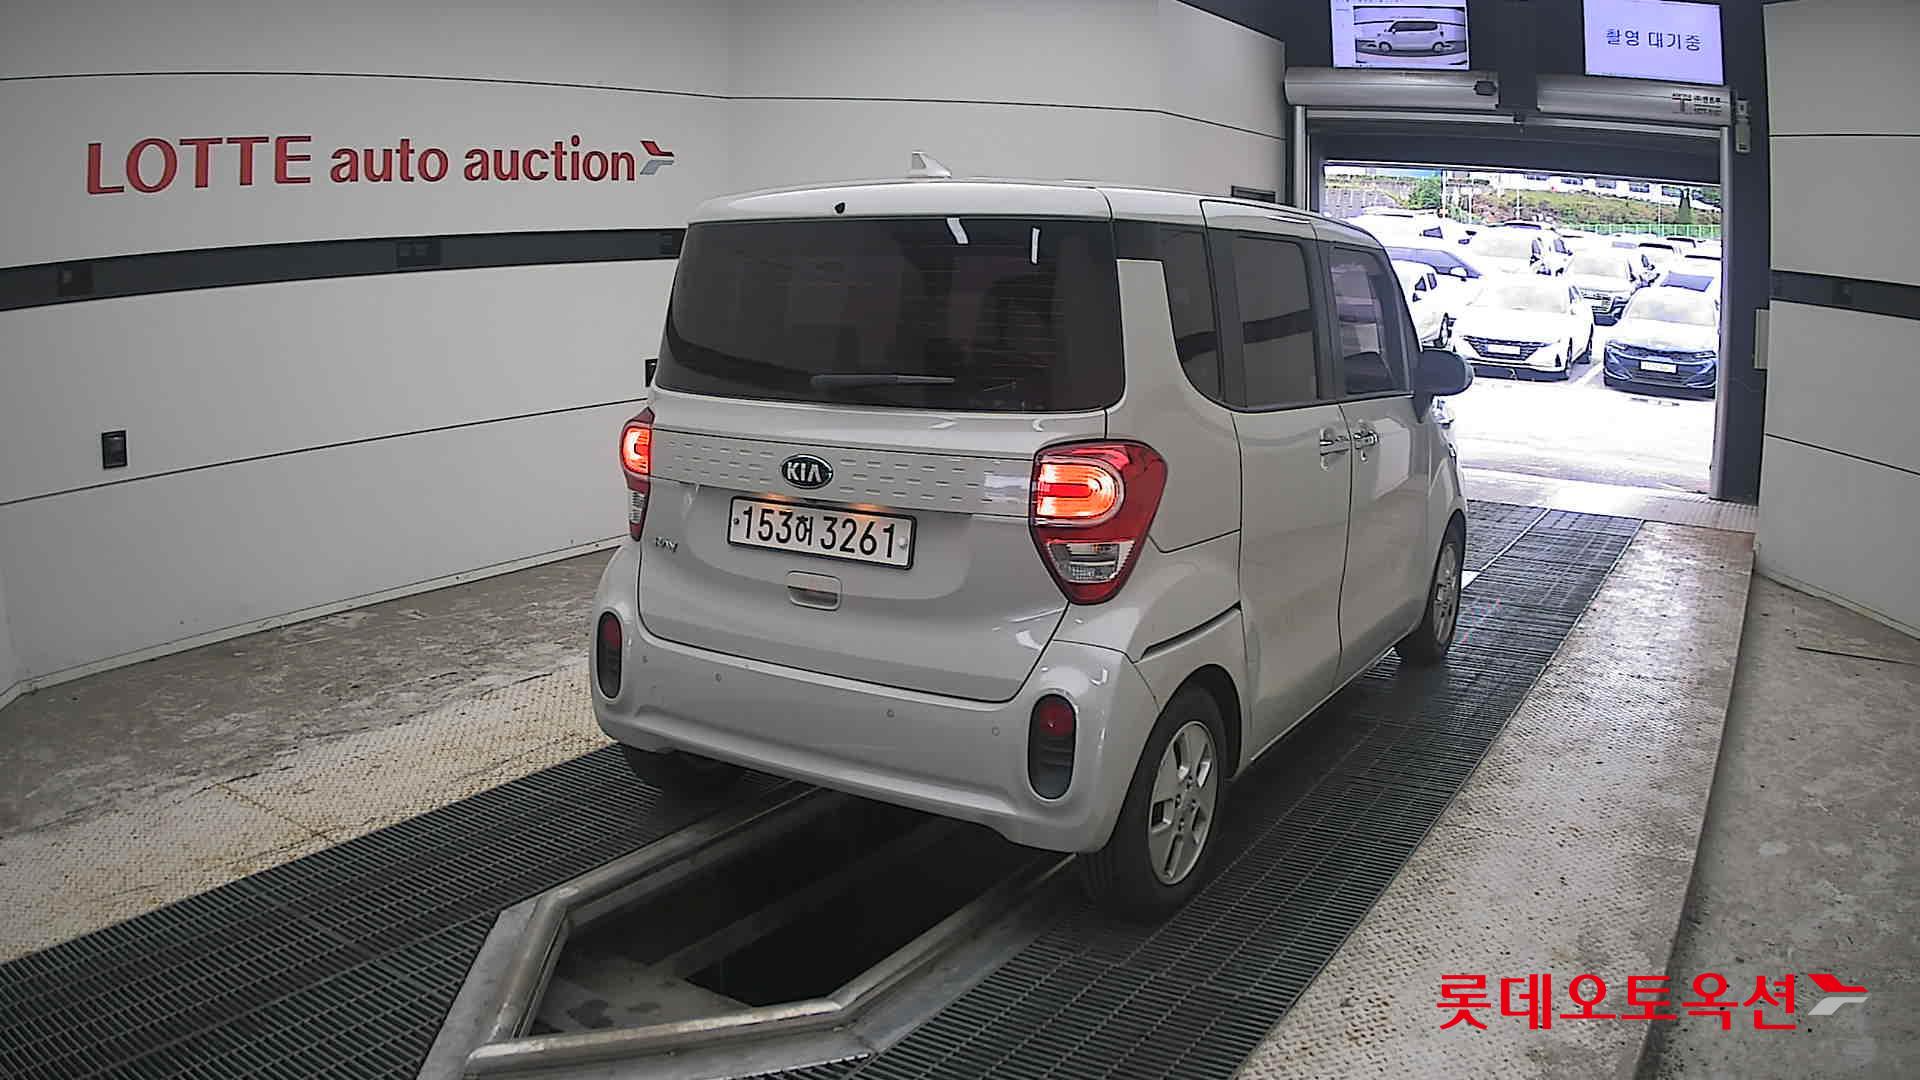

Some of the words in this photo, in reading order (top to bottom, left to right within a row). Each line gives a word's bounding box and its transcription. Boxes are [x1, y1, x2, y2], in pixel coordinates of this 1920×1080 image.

[87, 135, 312, 195] LOTTE
[329, 137, 449, 184] auto
[463, 134, 636, 182] auction
[785, 459, 826, 485] KIA
[820, 516, 896, 559] 3261
